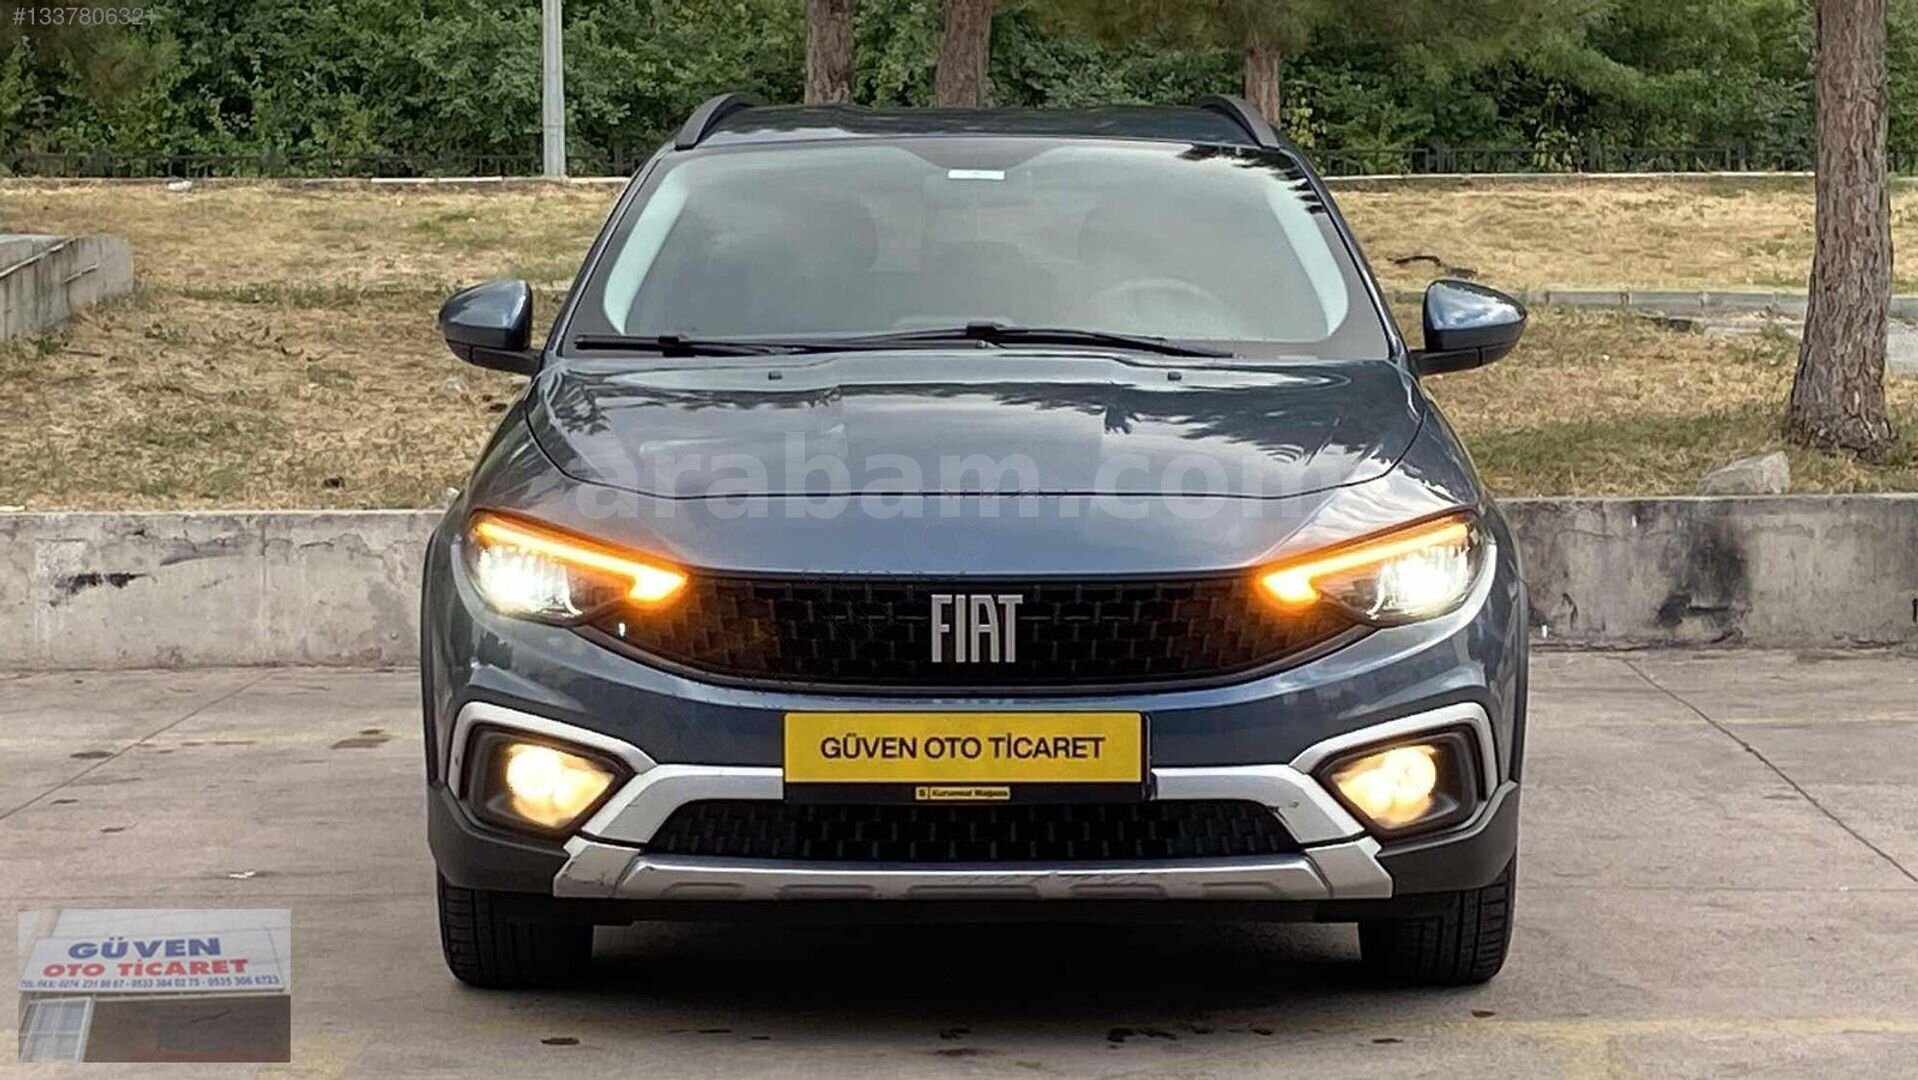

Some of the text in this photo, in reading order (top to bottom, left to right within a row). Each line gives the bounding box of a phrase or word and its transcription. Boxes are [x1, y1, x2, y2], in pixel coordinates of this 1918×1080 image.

[930, 593, 1024, 663] FIAT
[820, 732, 1106, 759] GÜVEN OTO TİCARET
